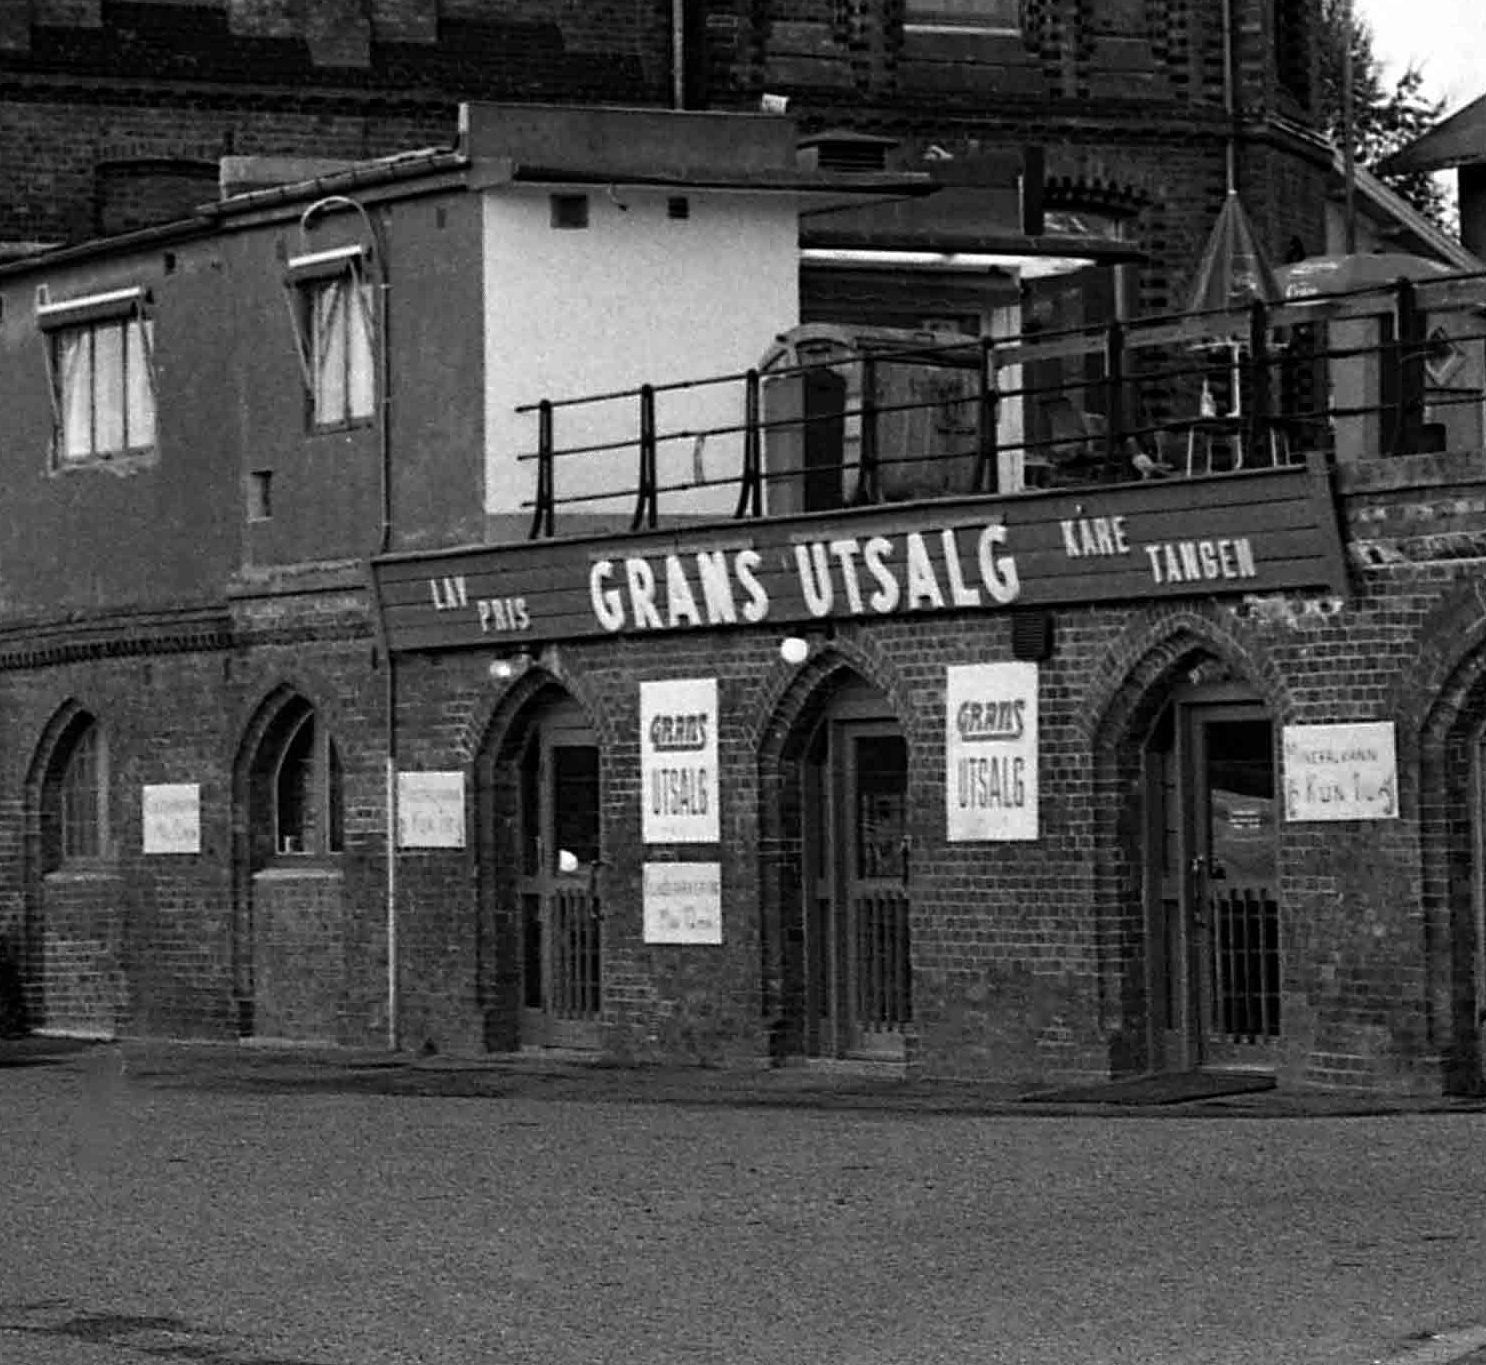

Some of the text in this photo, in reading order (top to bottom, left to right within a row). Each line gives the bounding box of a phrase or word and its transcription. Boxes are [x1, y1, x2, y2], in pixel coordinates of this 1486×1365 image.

[589, 522, 1021, 632] GRANS UTSALG
[1145, 538, 1257, 584] TANGEN
[477, 597, 531, 633] PRIS
[650, 712, 708, 752] GRANS
[955, 699, 1026, 742] GRANS
[651, 767, 707, 816] UTSALG
[957, 756, 1025, 809] UTSALG
